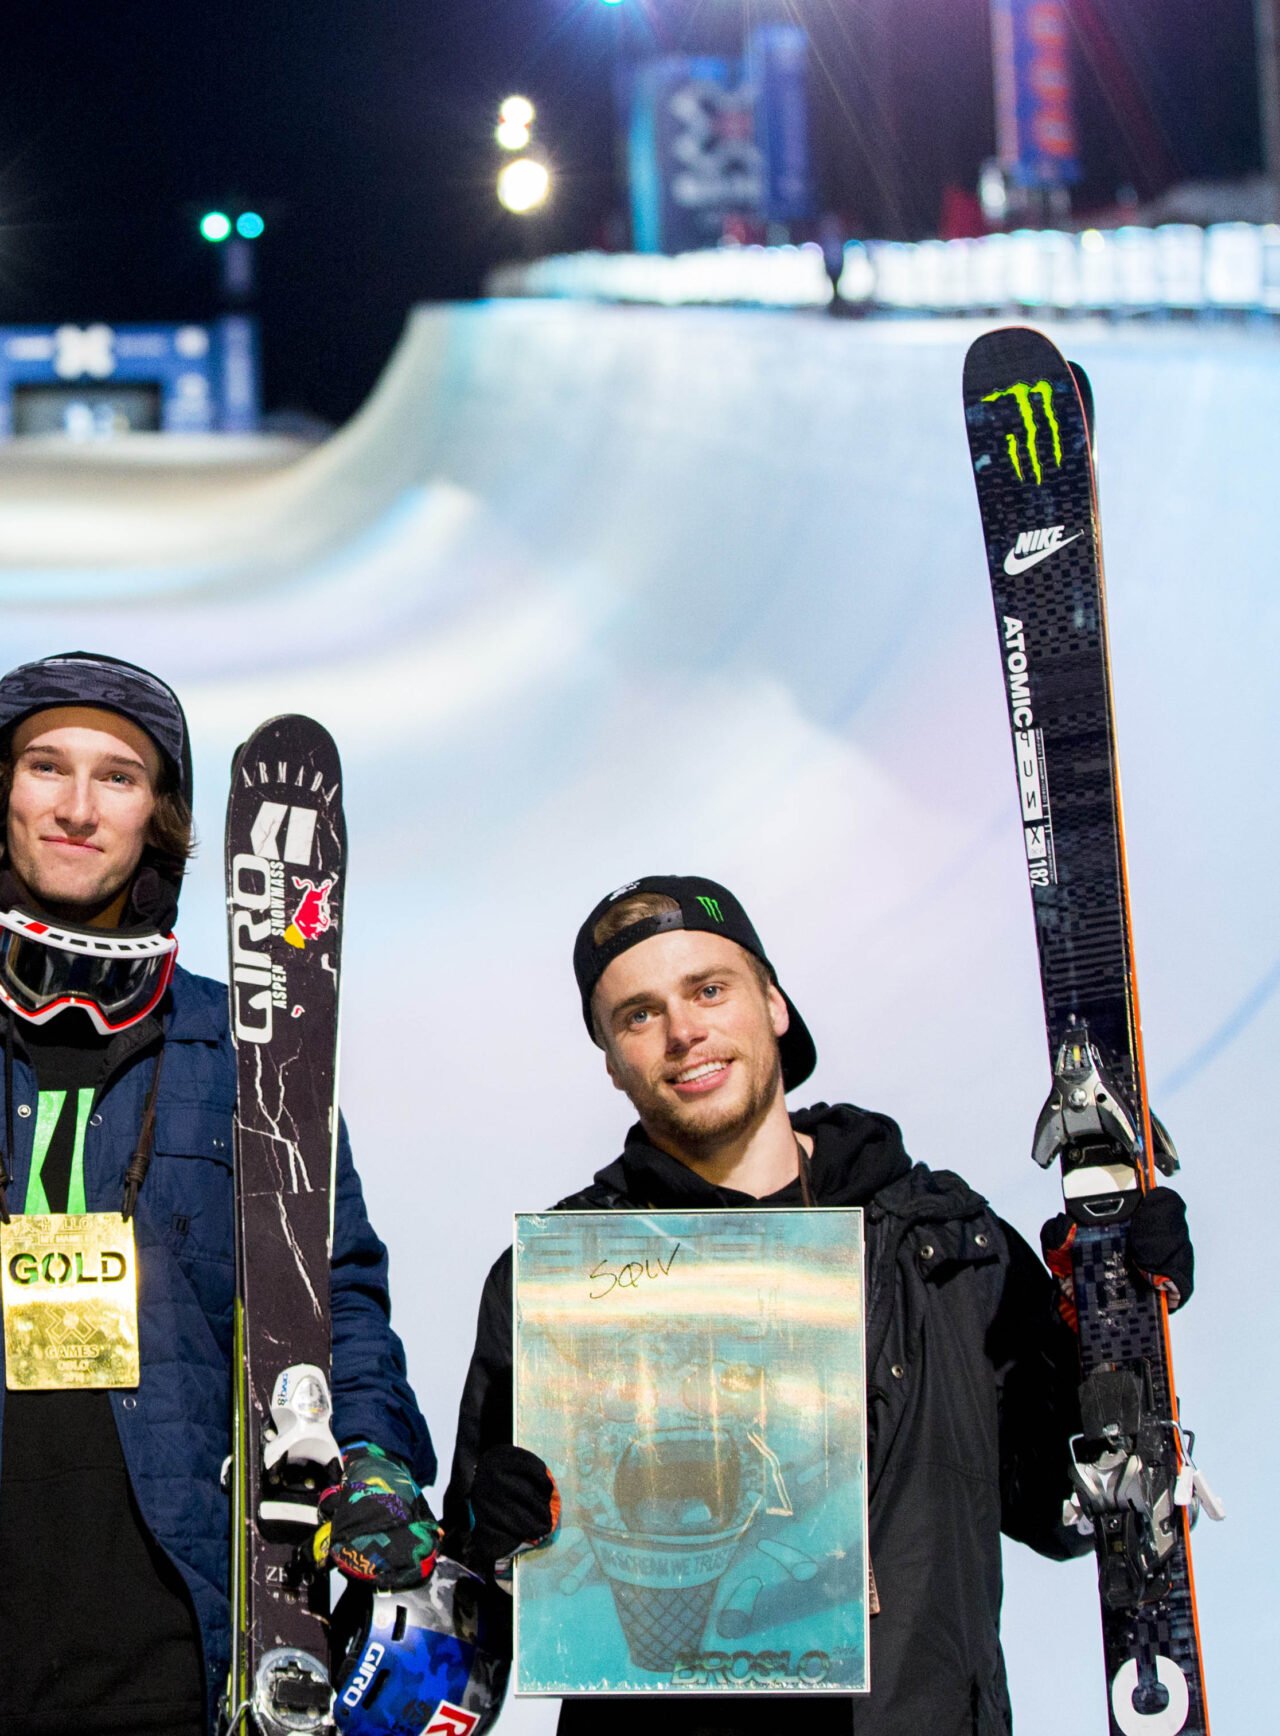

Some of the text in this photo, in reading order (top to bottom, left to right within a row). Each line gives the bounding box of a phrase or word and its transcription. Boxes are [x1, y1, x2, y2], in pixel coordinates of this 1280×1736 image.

[1015, 525, 1065, 554] NIKE
[1003, 615, 1034, 728] ATOMIC
[241, 761, 339, 802] ARMADA
[1029, 859, 1050, 888] 182
[233, 853, 273, 1044] GIRO
[270, 860, 287, 1009] ASPEN SNOWMASS
[9, 1252, 127, 1284] GOLD
[46, 1344, 100, 1359] GAMES
[343, 1641, 385, 1707] GIRO
